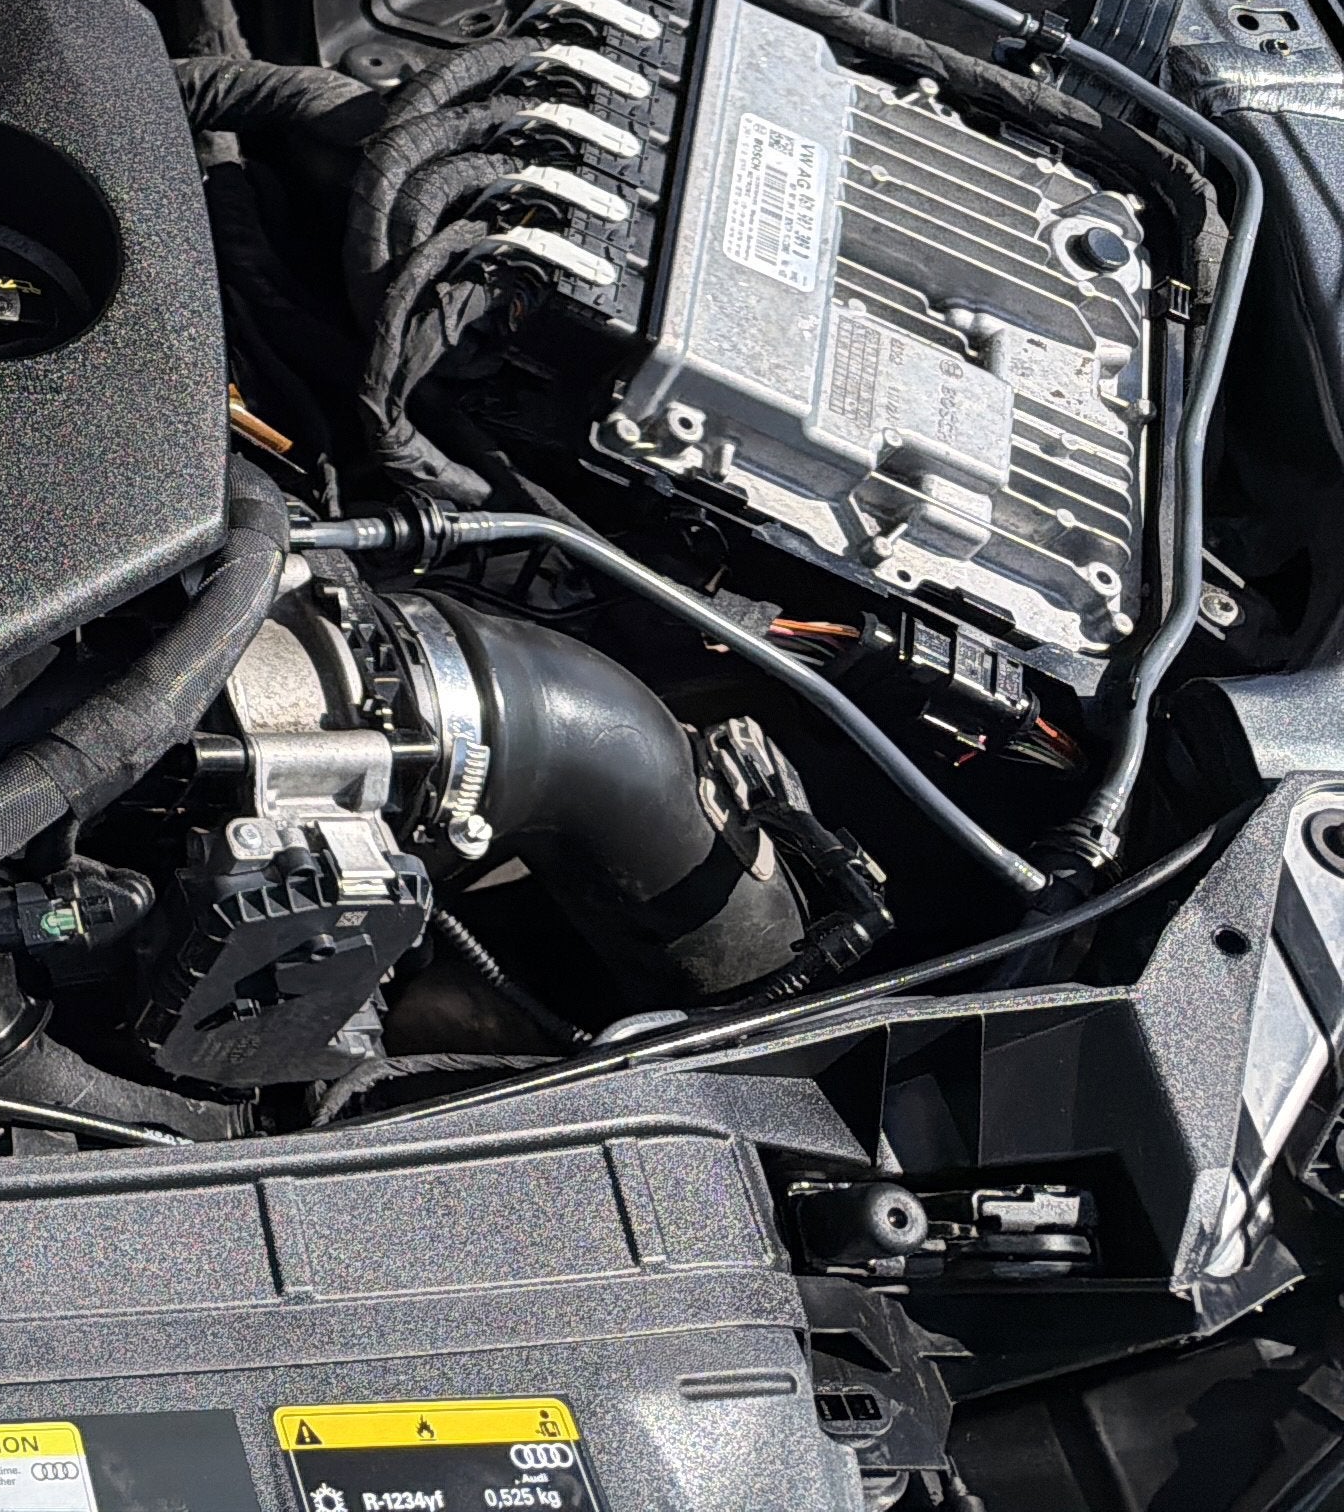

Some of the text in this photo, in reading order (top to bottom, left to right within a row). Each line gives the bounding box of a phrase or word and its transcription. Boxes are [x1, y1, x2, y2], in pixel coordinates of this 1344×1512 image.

[750, 137, 764, 172] BOSCH
[799, 140, 815, 169] VW
[796, 166, 812, 191] AG
[522, 1473, 549, 1484] Audi
[362, 1487, 562, 1511] R-1234yf 0,525 kg
